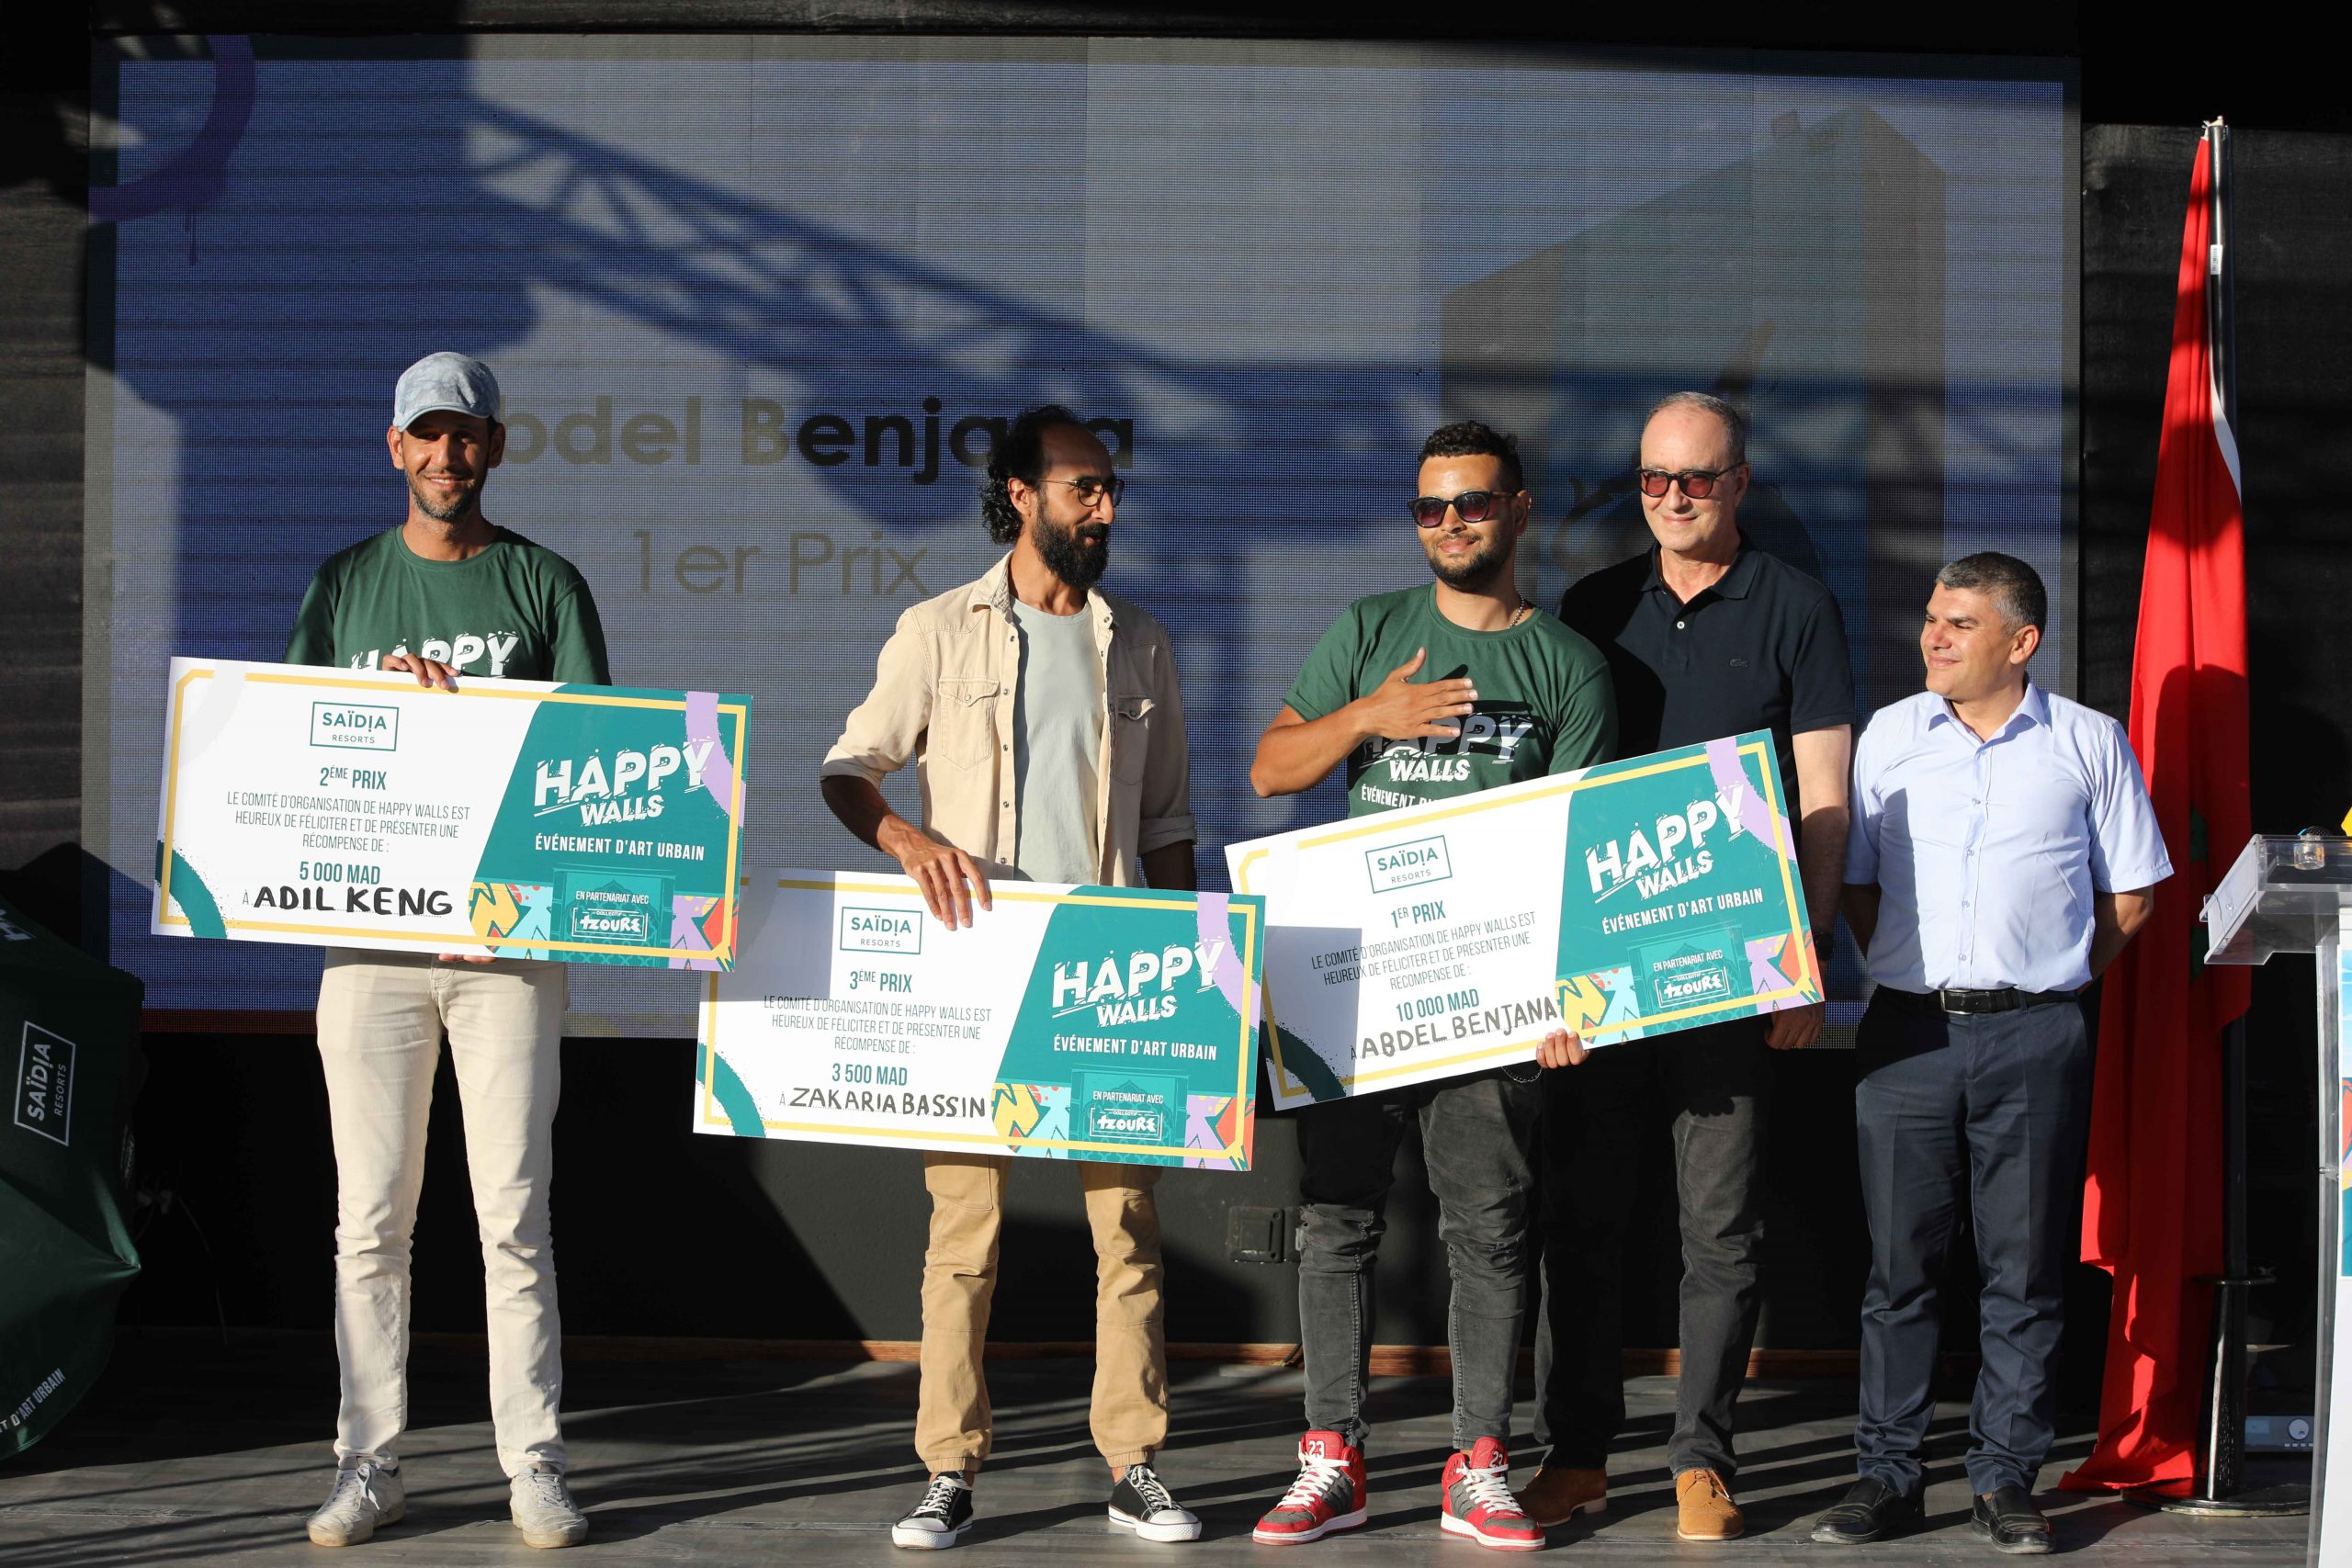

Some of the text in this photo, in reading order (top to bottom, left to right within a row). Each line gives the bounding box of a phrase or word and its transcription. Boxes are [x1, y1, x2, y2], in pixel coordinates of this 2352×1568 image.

[499, 394, 1134, 485] bdel Benjaa
[633, 530, 930, 596] 1er Prix
[351, 631, 520, 678] HPPY
[332, 734, 375, 744] RESORTS
[352, 769, 387, 790] PRIX
[534, 736, 715, 812] HAPPY
[1389, 759, 1470, 782] WALLS
[227, 791, 470, 820] LE COMITÉ D'ORGANISATION DE HAPPY WALLS EST
[1362, 784, 1416, 807] ÉVÉNEMENT
[235, 810, 459, 839] HEUREUX DE FÉLICITER ET DE PRÉSENTER UNE
[580, 795, 664, 827] WALLS
[302, 833, 368, 852] RÉCOMPENSE
[371, 838, 384, 852] DE
[535, 833, 705, 861] ÉVÉNEMENT D'ART URBAIN
[1585, 782, 1745, 897] HAPPY
[300, 861, 380, 885] 5 000 MAD
[1391, 869, 1431, 884] RESORTS
[1635, 850, 1714, 901] WALLS
[242, 885, 453, 917] À ADIL KENG
[575, 890, 650, 905] EN PARTENARIAT AVEC
[1601, 887, 1764, 935] ÉVÉNEMENT D'ART URBAIN
[1391, 899, 1446, 929] 1ER PRIX
[860, 938, 901, 948] RESORTS
[1311, 911, 1537, 970] LE COMITÉ D'ORGANISATION DE HAPPY WALLS EST
[1323, 931, 1532, 986] HEUREUX DE FÉLICITER ET DE PRÉSENTER UNE
[1653, 949, 1724, 972] EN PARTENARIAT AVEC
[879, 973, 912, 993] PRIX
[1052, 936, 1227, 1014] HAPPY
[1389, 968, 1452, 991] RÉCOMPENSE
[1453, 964, 1466, 979] DE
[763, 995, 992, 1022] LE COMITÉ D'ORGANISATION DE HAPPY WALLS EST
[1096, 995, 1178, 1028] WALLS
[1396, 987, 1480, 1021] 10 000 MAD
[772, 1014, 981, 1040] HEUREUX DE FÉLICITER ET DE PRÉSENTER UNE
[1351, 996, 1558, 1060] À ABDEL BENJANA
[834, 1034, 896, 1053] RÉCOMPENSE
[899, 1040, 910, 1054] DE
[1053, 1033, 1217, 1061] ÉVÉNEMENT D'ART URBAIN
[831, 1063, 908, 1086] 3 500 MAD
[54, 1064, 67, 1116] RESORTS
[779, 1087, 986, 1118] À ZAKARIA BASSIN
[1092, 1090, 1164, 1104] EN PARTENARIAT AVEC
[10, 1396, 36, 1427] D'ART
[32, 1368, 66, 1404] URBAIN
[1307, 1439, 1325, 1459] 23
